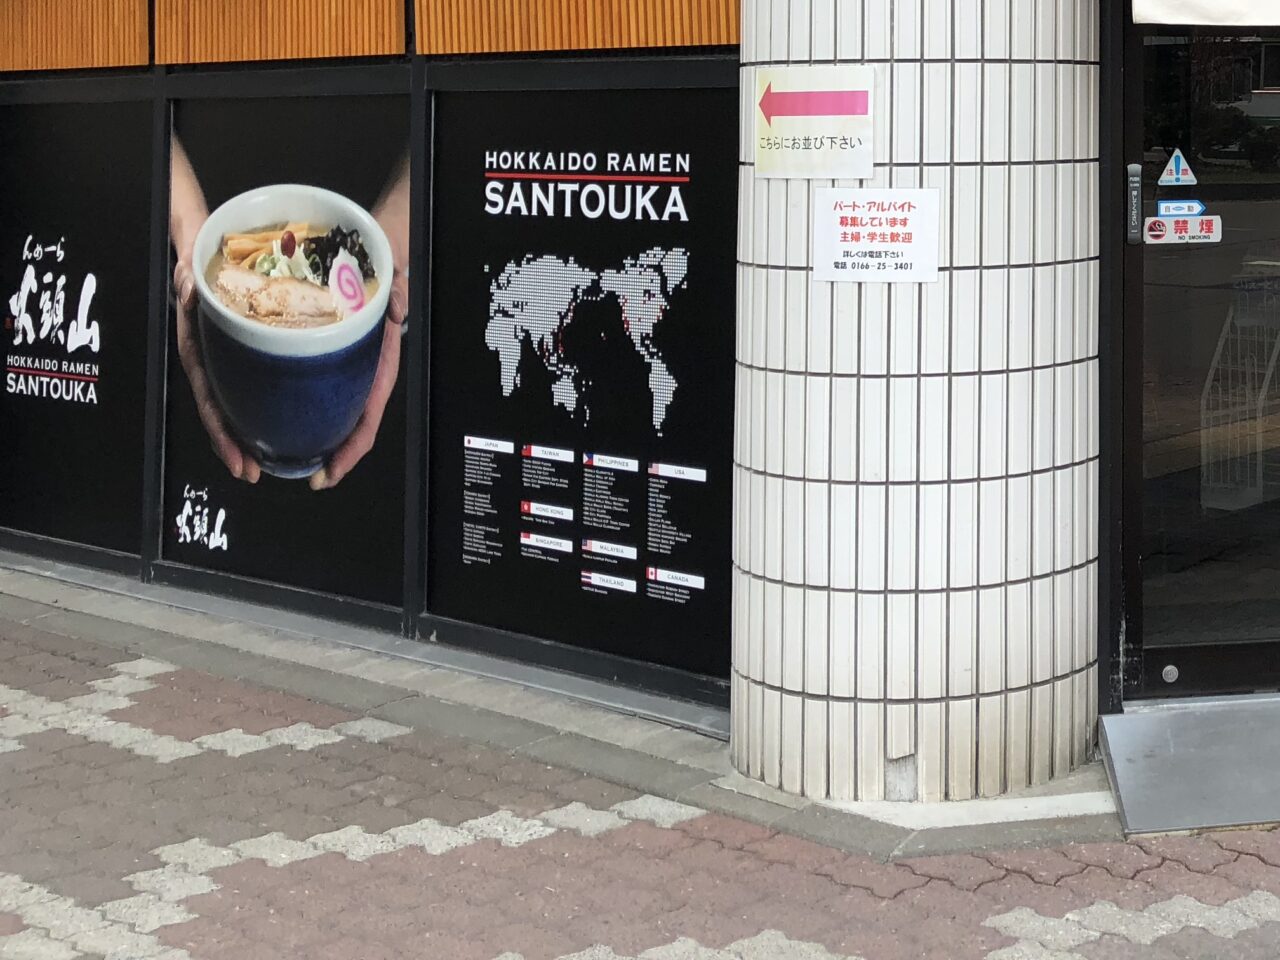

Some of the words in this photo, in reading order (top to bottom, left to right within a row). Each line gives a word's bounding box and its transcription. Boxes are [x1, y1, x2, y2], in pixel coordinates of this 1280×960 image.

[759, 135, 863, 151] こちらにお並び下さい
[484, 151, 597, 171] HOKKAIDO
[607, 153, 690, 172] RAMEN
[484, 180, 690, 222] SANTOUKA
[839, 216, 910, 228] 募集しています
[1173, 219, 1214, 234] 禁煙
[839, 231, 913, 244] 主婦・学生歓迎
[7, 354, 58, 372] HOKKAIDO
[62, 362, 99, 376] RAMEN
[6, 372, 98, 404] SANTOUKA
